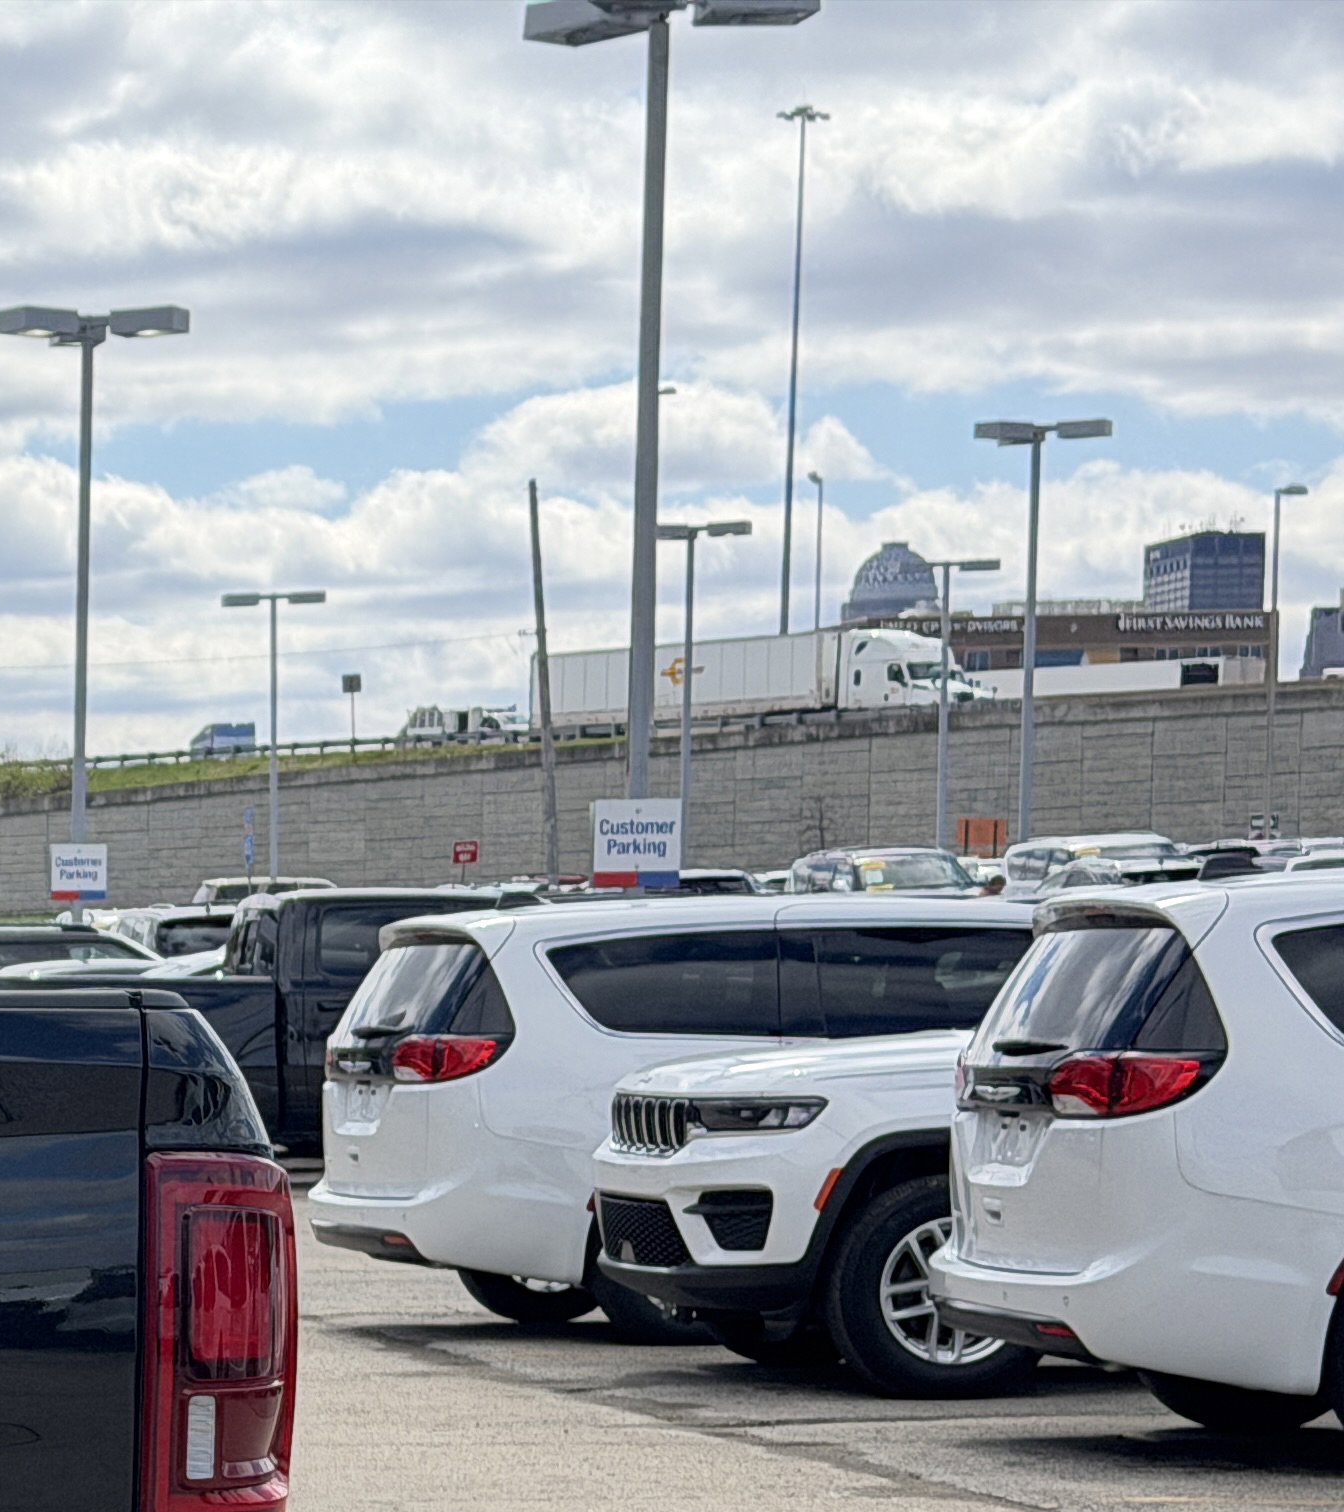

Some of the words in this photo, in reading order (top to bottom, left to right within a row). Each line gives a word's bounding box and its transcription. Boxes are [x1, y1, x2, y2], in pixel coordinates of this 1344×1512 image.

[1125, 616, 1163, 631] FIRST
[1163, 615, 1223, 631] SAVINGS
[1224, 614, 1265, 629] BANK
[599, 818, 676, 836] Customer
[606, 838, 667, 857] Parking
[59, 869, 98, 882] Parking
